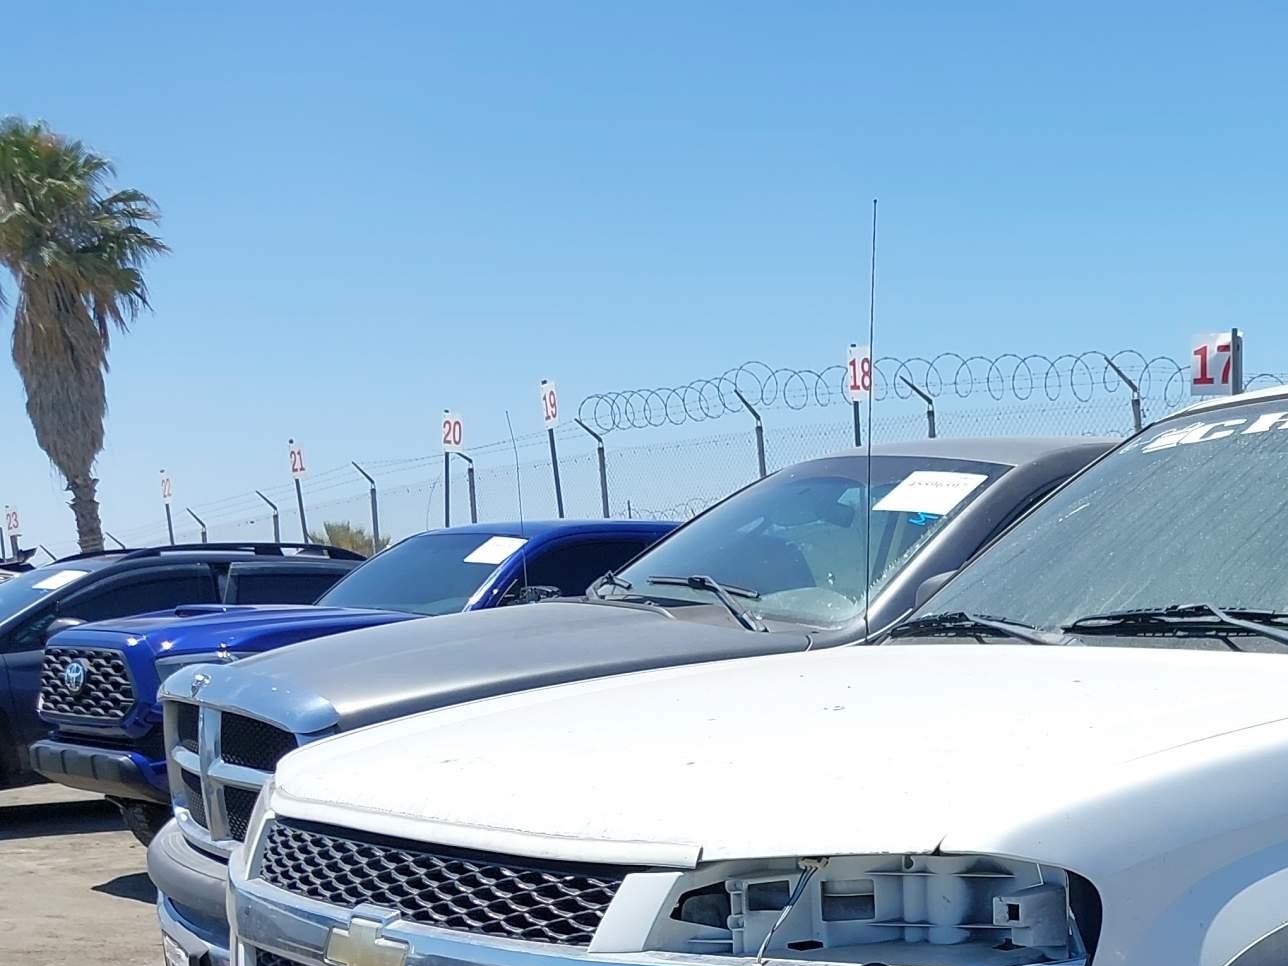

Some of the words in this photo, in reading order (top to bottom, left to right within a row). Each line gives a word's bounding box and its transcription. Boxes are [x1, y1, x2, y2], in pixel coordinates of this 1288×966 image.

[849, 357, 872, 391] 18
[1193, 345, 1231, 385] 17
[542, 390, 557, 420] 19
[443, 420, 462, 445] 20
[290, 450, 305, 472] 21
[6, 511, 19, 530] 23
